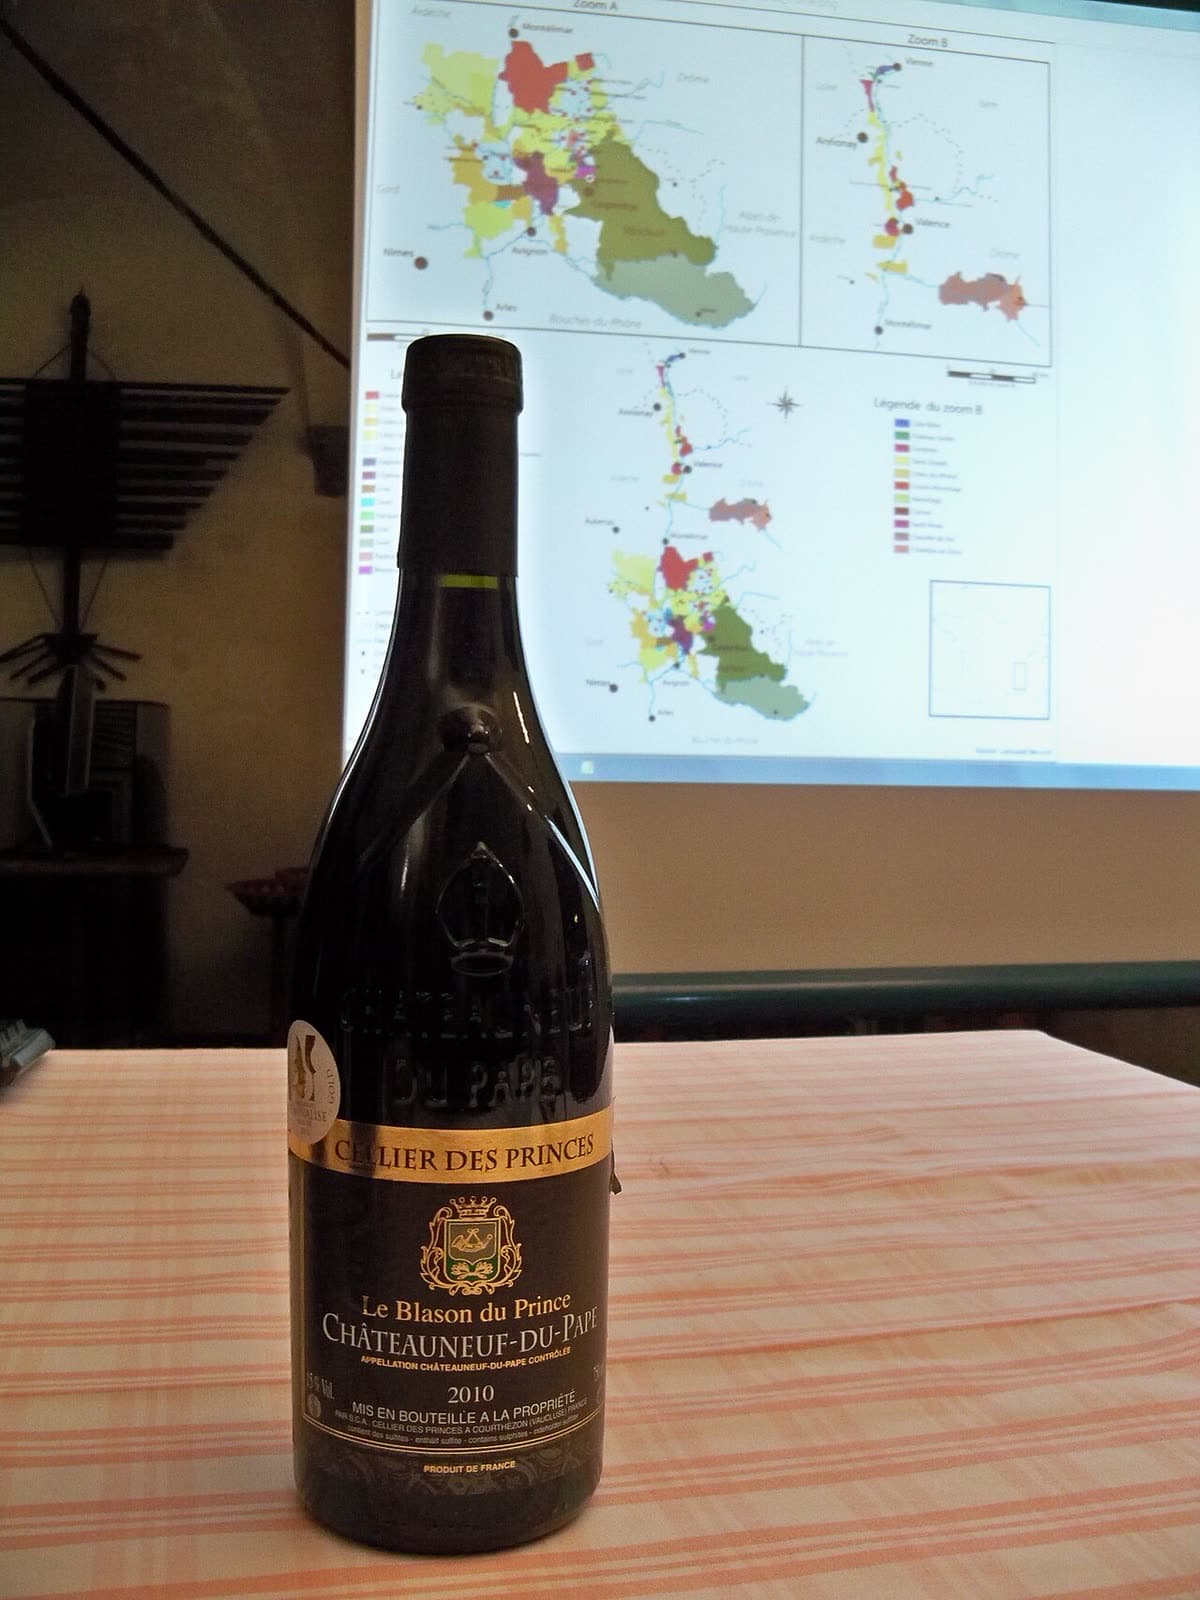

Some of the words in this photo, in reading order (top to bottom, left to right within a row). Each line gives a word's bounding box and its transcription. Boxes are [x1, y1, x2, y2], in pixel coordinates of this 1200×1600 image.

[908, 35, 937, 47] Zoom
[446, 1150, 498, 1172] DES
[505, 1134, 594, 1169] PRINCES
[362, 1295, 389, 1318] Le
[396, 1300, 473, 1323] Blason
[480, 1303, 507, 1321] du
[515, 1294, 571, 1319] Prince
[361, 1355, 418, 1370] APPELLATION
[420, 1357, 527, 1372] CHÂTEAUNEUF-DU-PAPE
[447, 1384, 495, 1404] 2010
[352, 1401, 374, 1418] MIS
[377, 1406, 396, 1421] EN
[399, 1410, 476, 1425] BOUTEILLE
[480, 1411, 491, 1424] A
[493, 1409, 511, 1423] LA
[513, 1389, 577, 1419] PROPRIÉTÉ
[372, 1420, 405, 1432] CELLIER
[406, 1424, 424, 1434] DES
[425, 1426, 463, 1435] PRINCES
[423, 1464, 464, 1475] PRODUIT
[466, 1464, 479, 1474] DE
[480, 1460, 516, 1473] FRANCE
